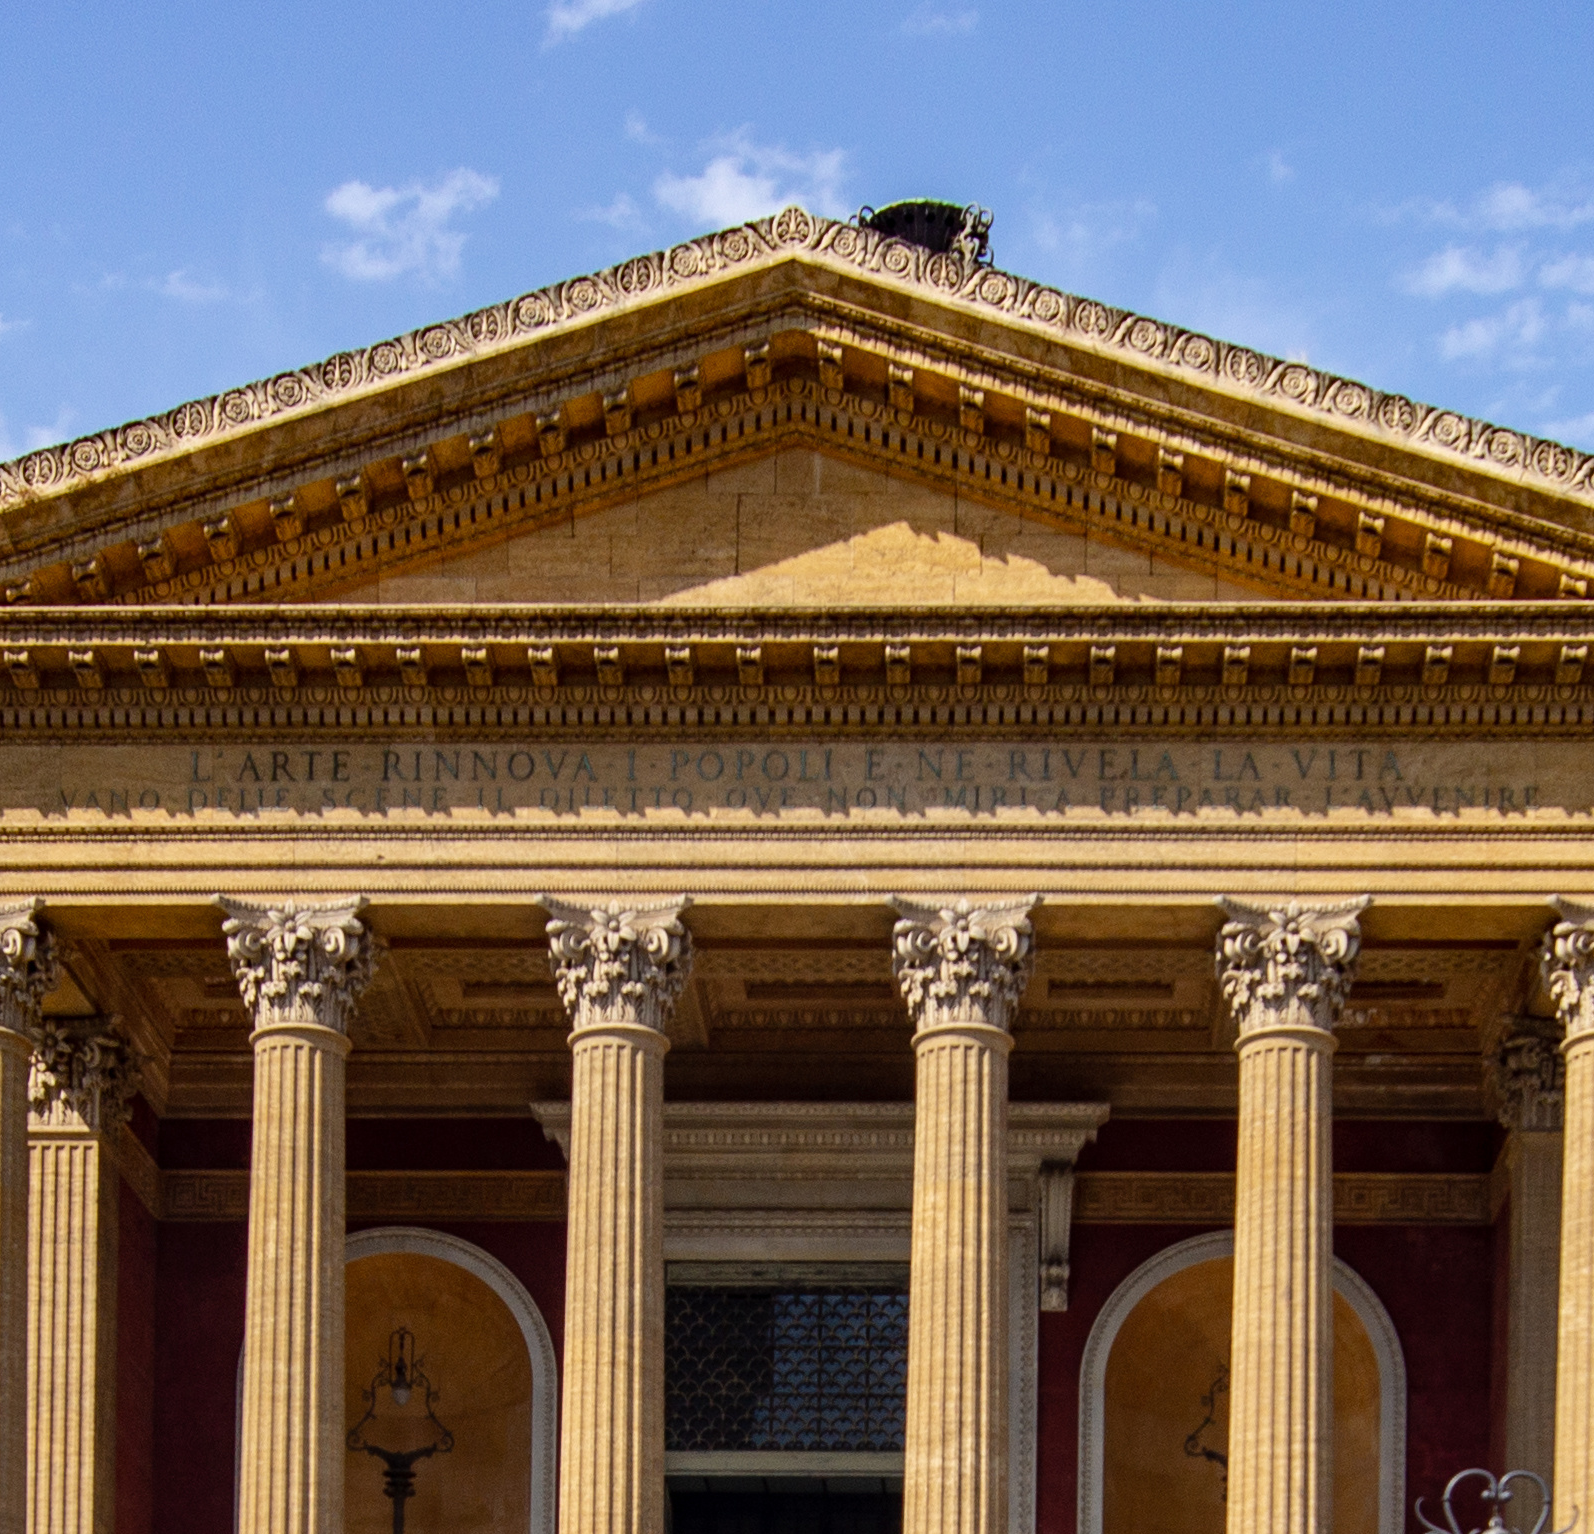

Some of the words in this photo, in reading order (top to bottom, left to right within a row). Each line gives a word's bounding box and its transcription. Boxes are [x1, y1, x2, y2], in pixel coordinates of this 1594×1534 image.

[190, 749, 351, 783] L'ARTE
[382, 749, 597, 783] RINNOVA
[627, 748, 637, 783] I
[670, 748, 834, 783] POPOLI
[864, 748, 887, 783] E
[915, 748, 976, 783] NE
[1008, 748, 1180, 783] RIVELA
[1212, 748, 1265, 783] LA
[1289, 748, 1405, 783] VITA
